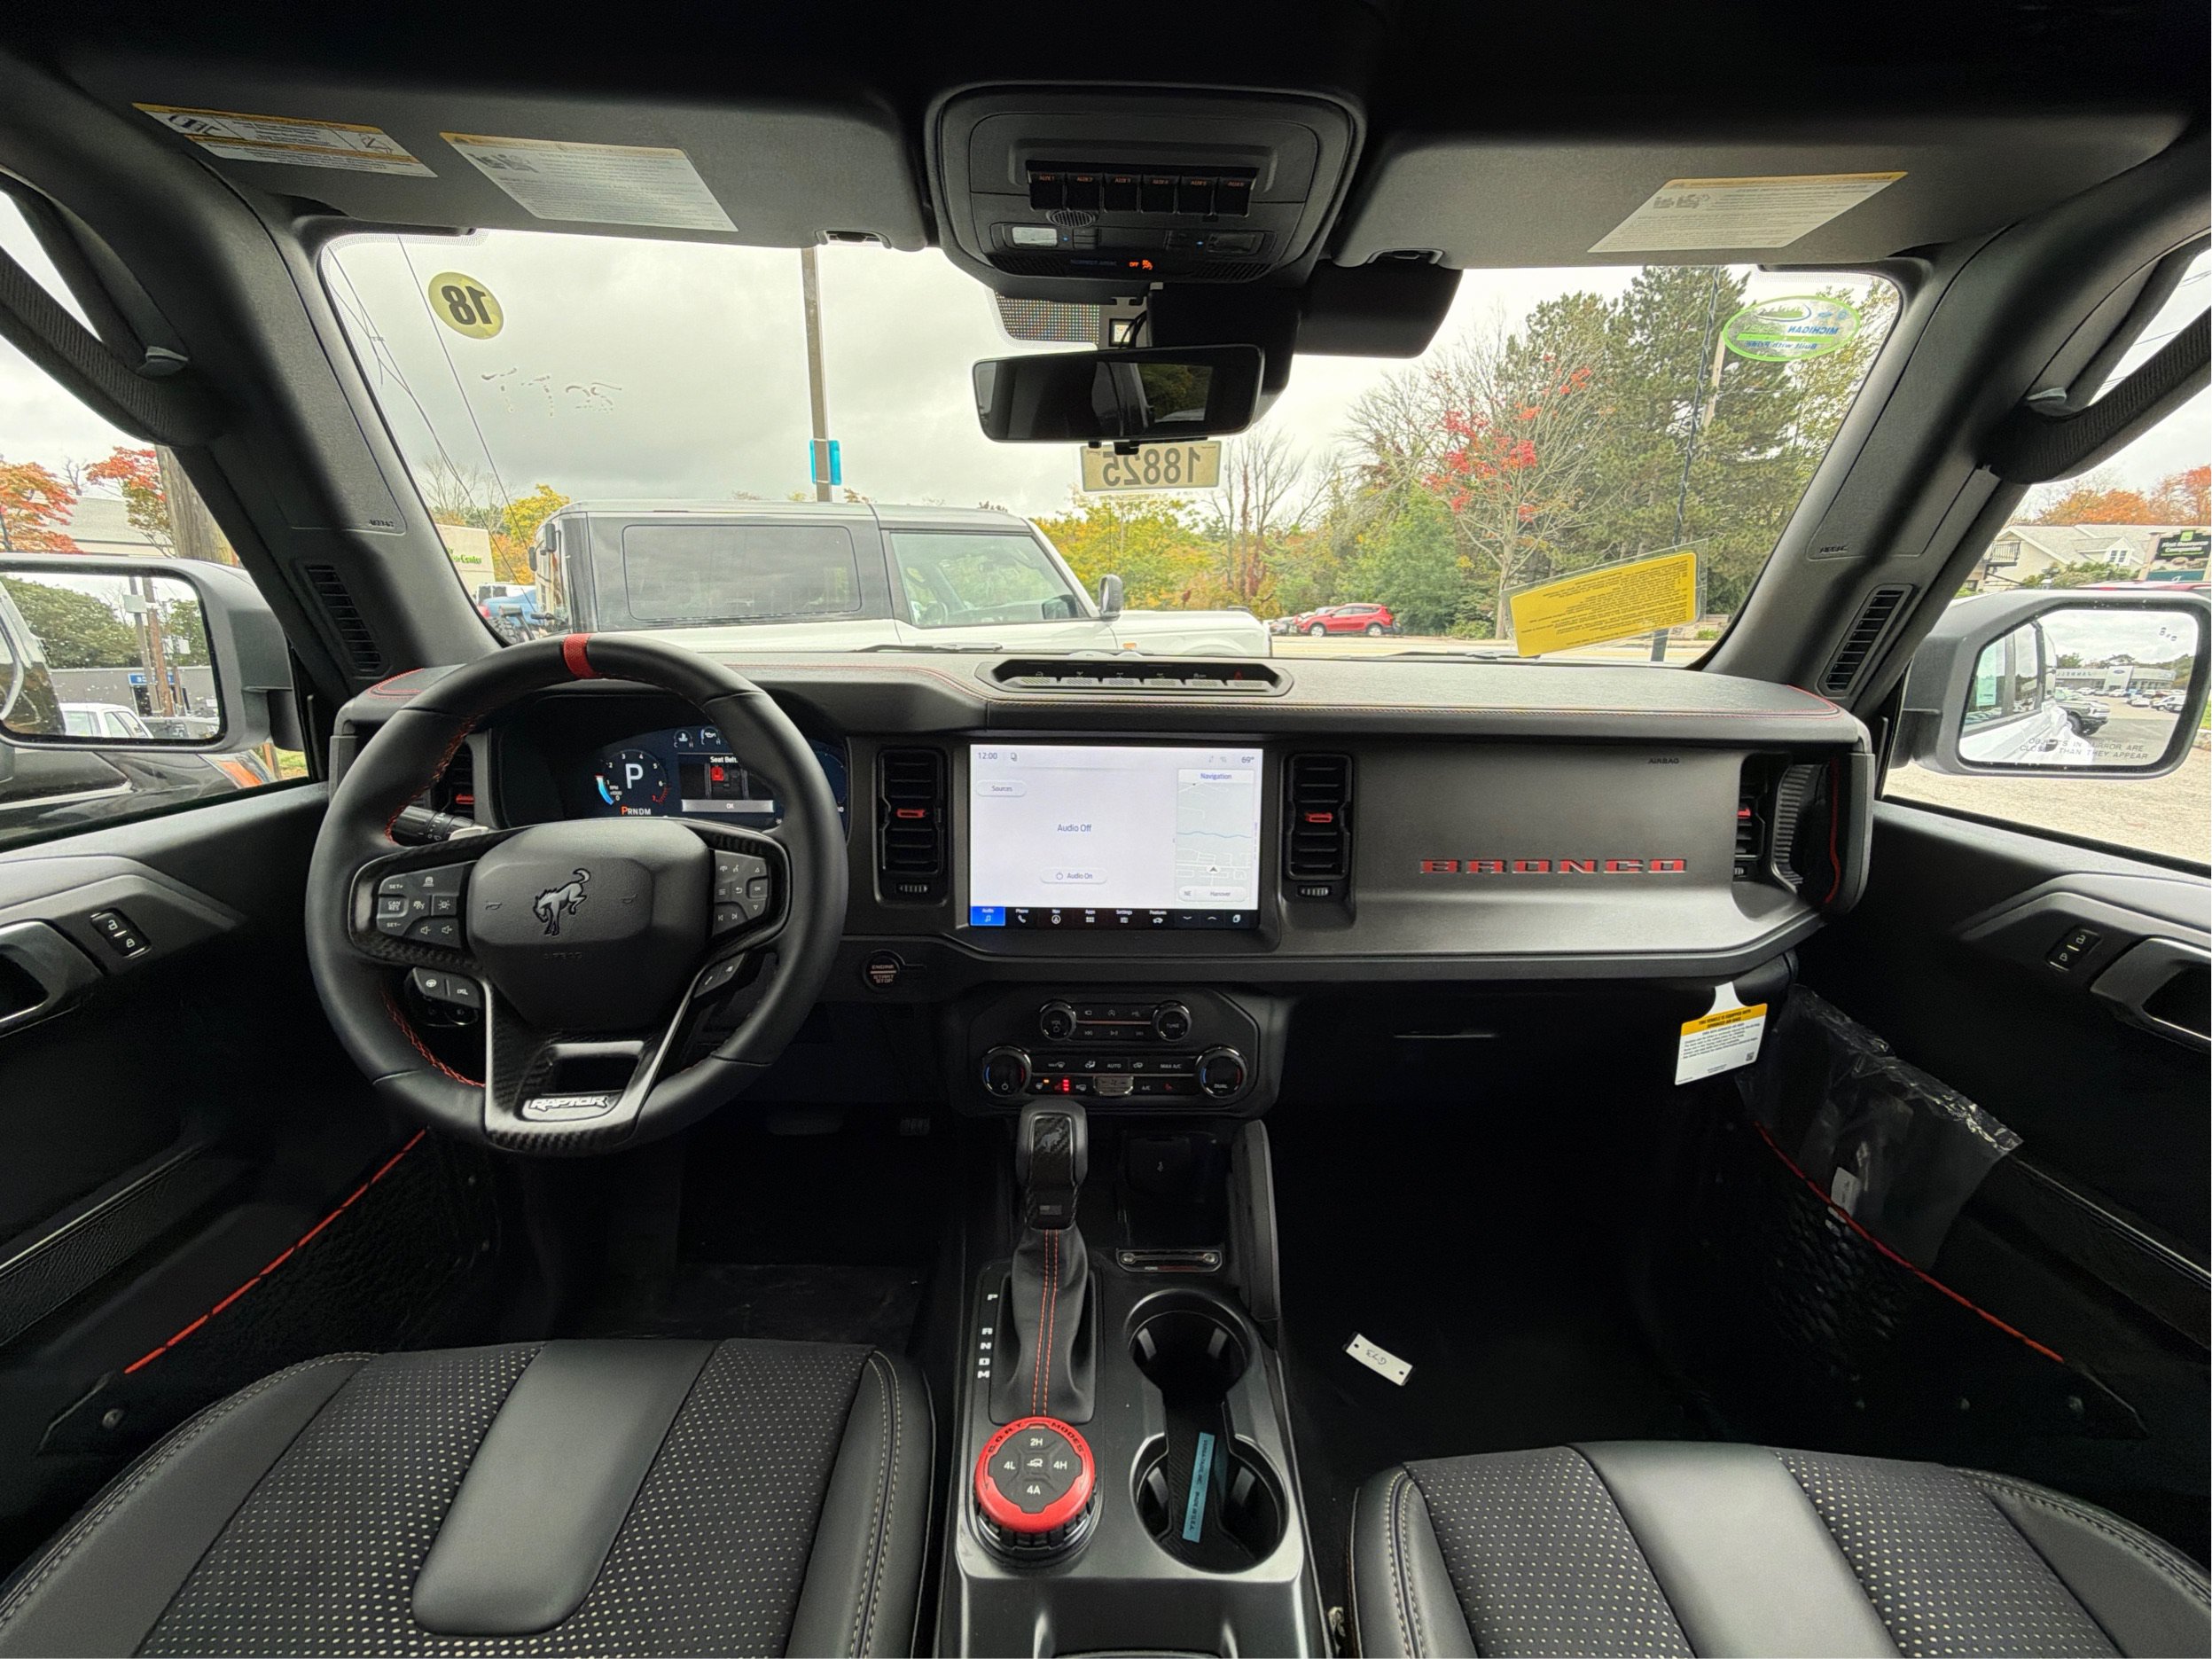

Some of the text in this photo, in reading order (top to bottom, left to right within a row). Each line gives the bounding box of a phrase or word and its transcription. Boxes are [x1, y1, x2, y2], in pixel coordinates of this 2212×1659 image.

[2087, 748, 2109, 757] THEY
[2112, 751, 2148, 760] APPEAR
[625, 763, 644, 789] P
[1200, 772, 1232, 781] Navigation
[1057, 824, 1091, 833] Audio Off
[1419, 858, 1686, 874] BRONCO
[530, 1096, 608, 1112] RAPTOR
[980, 1342, 992, 1350] N
[1029, 1437, 1043, 1447] 2H
[1051, 1421, 1084, 1453] MODES
[1003, 1460, 1016, 1470] 4L
[1053, 1460, 1067, 1470] 4H
[1026, 1485, 1041, 1495] 4A
